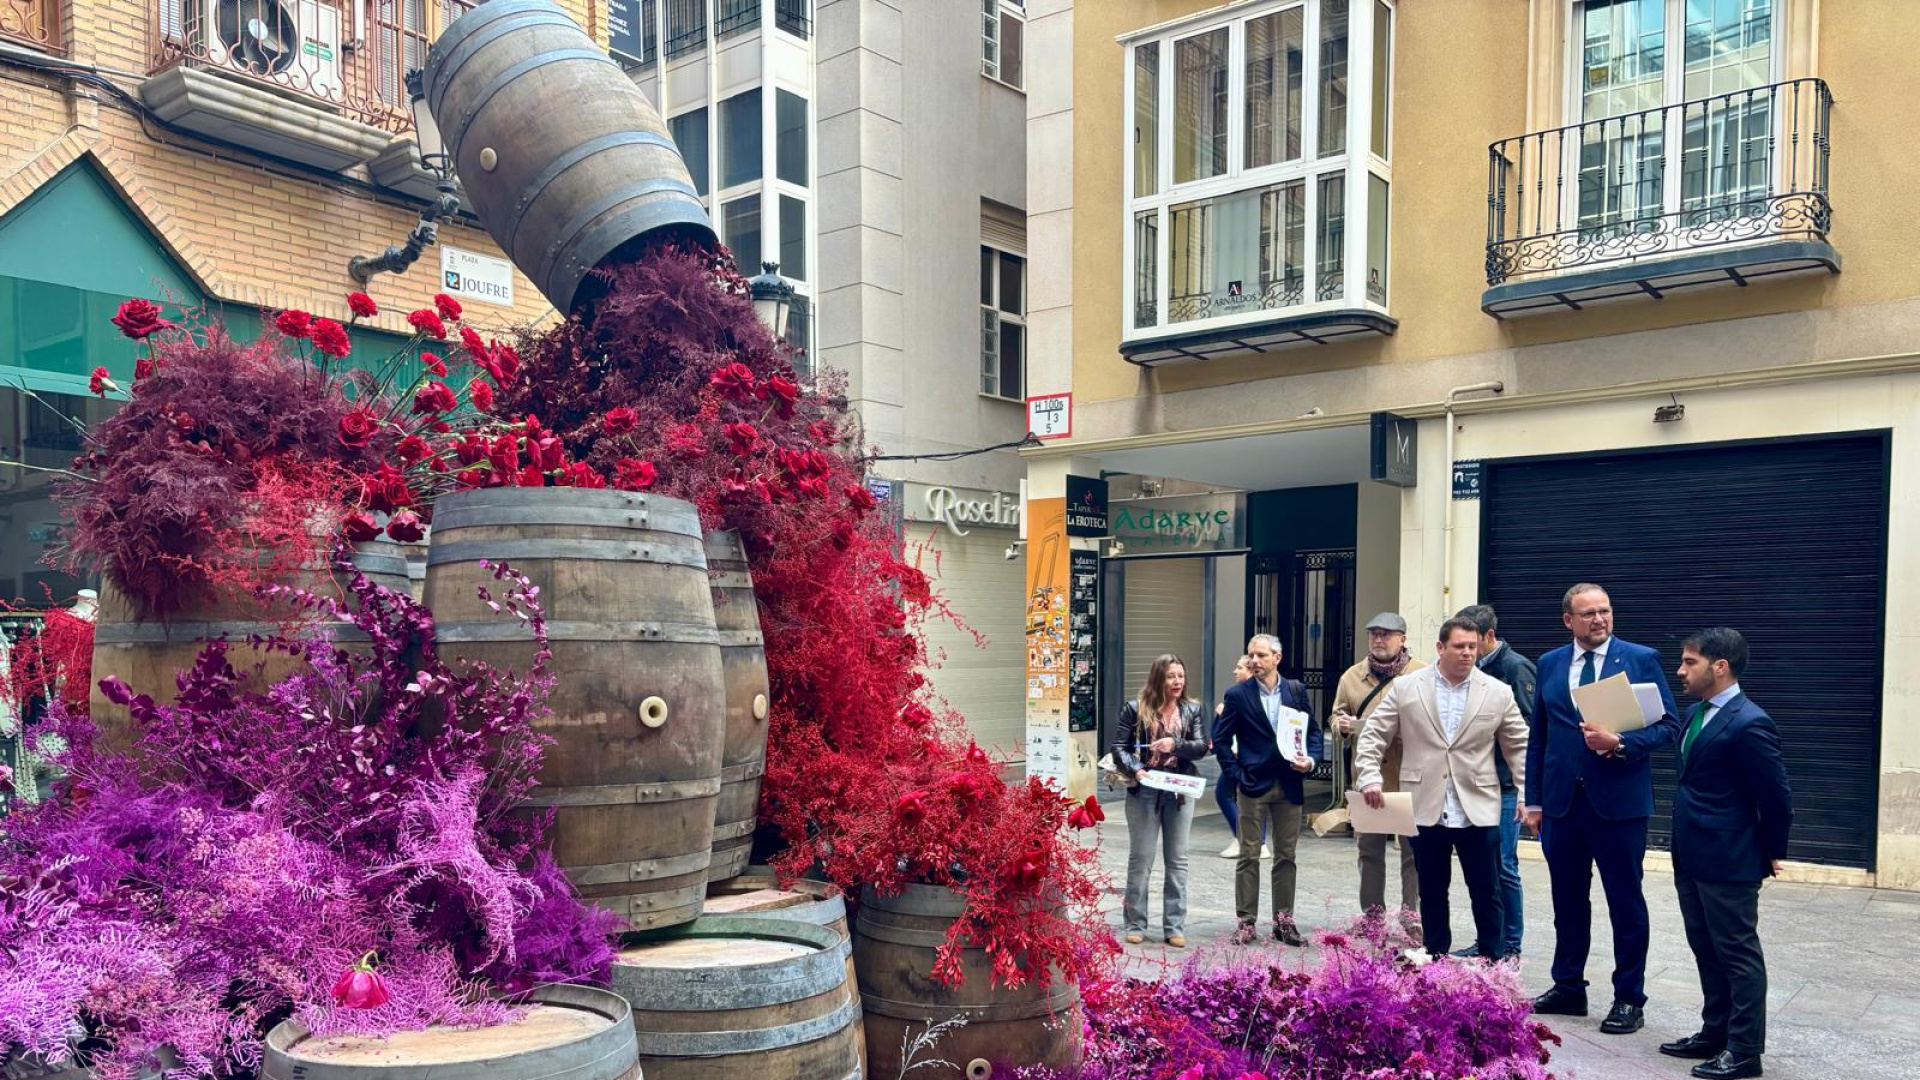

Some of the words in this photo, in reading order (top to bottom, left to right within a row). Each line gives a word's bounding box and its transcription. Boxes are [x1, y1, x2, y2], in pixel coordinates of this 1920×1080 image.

[461, 254, 478, 265] PLAZA
[461, 277, 509, 299] JOUFRE
[1214, 293, 1257, 307] ARNALDOS
[1035, 401, 1041, 411] H
[1045, 423, 1052, 434] 5
[1075, 516, 1107, 529] EROTECA
[1115, 531, 1226, 548] LATERIA
